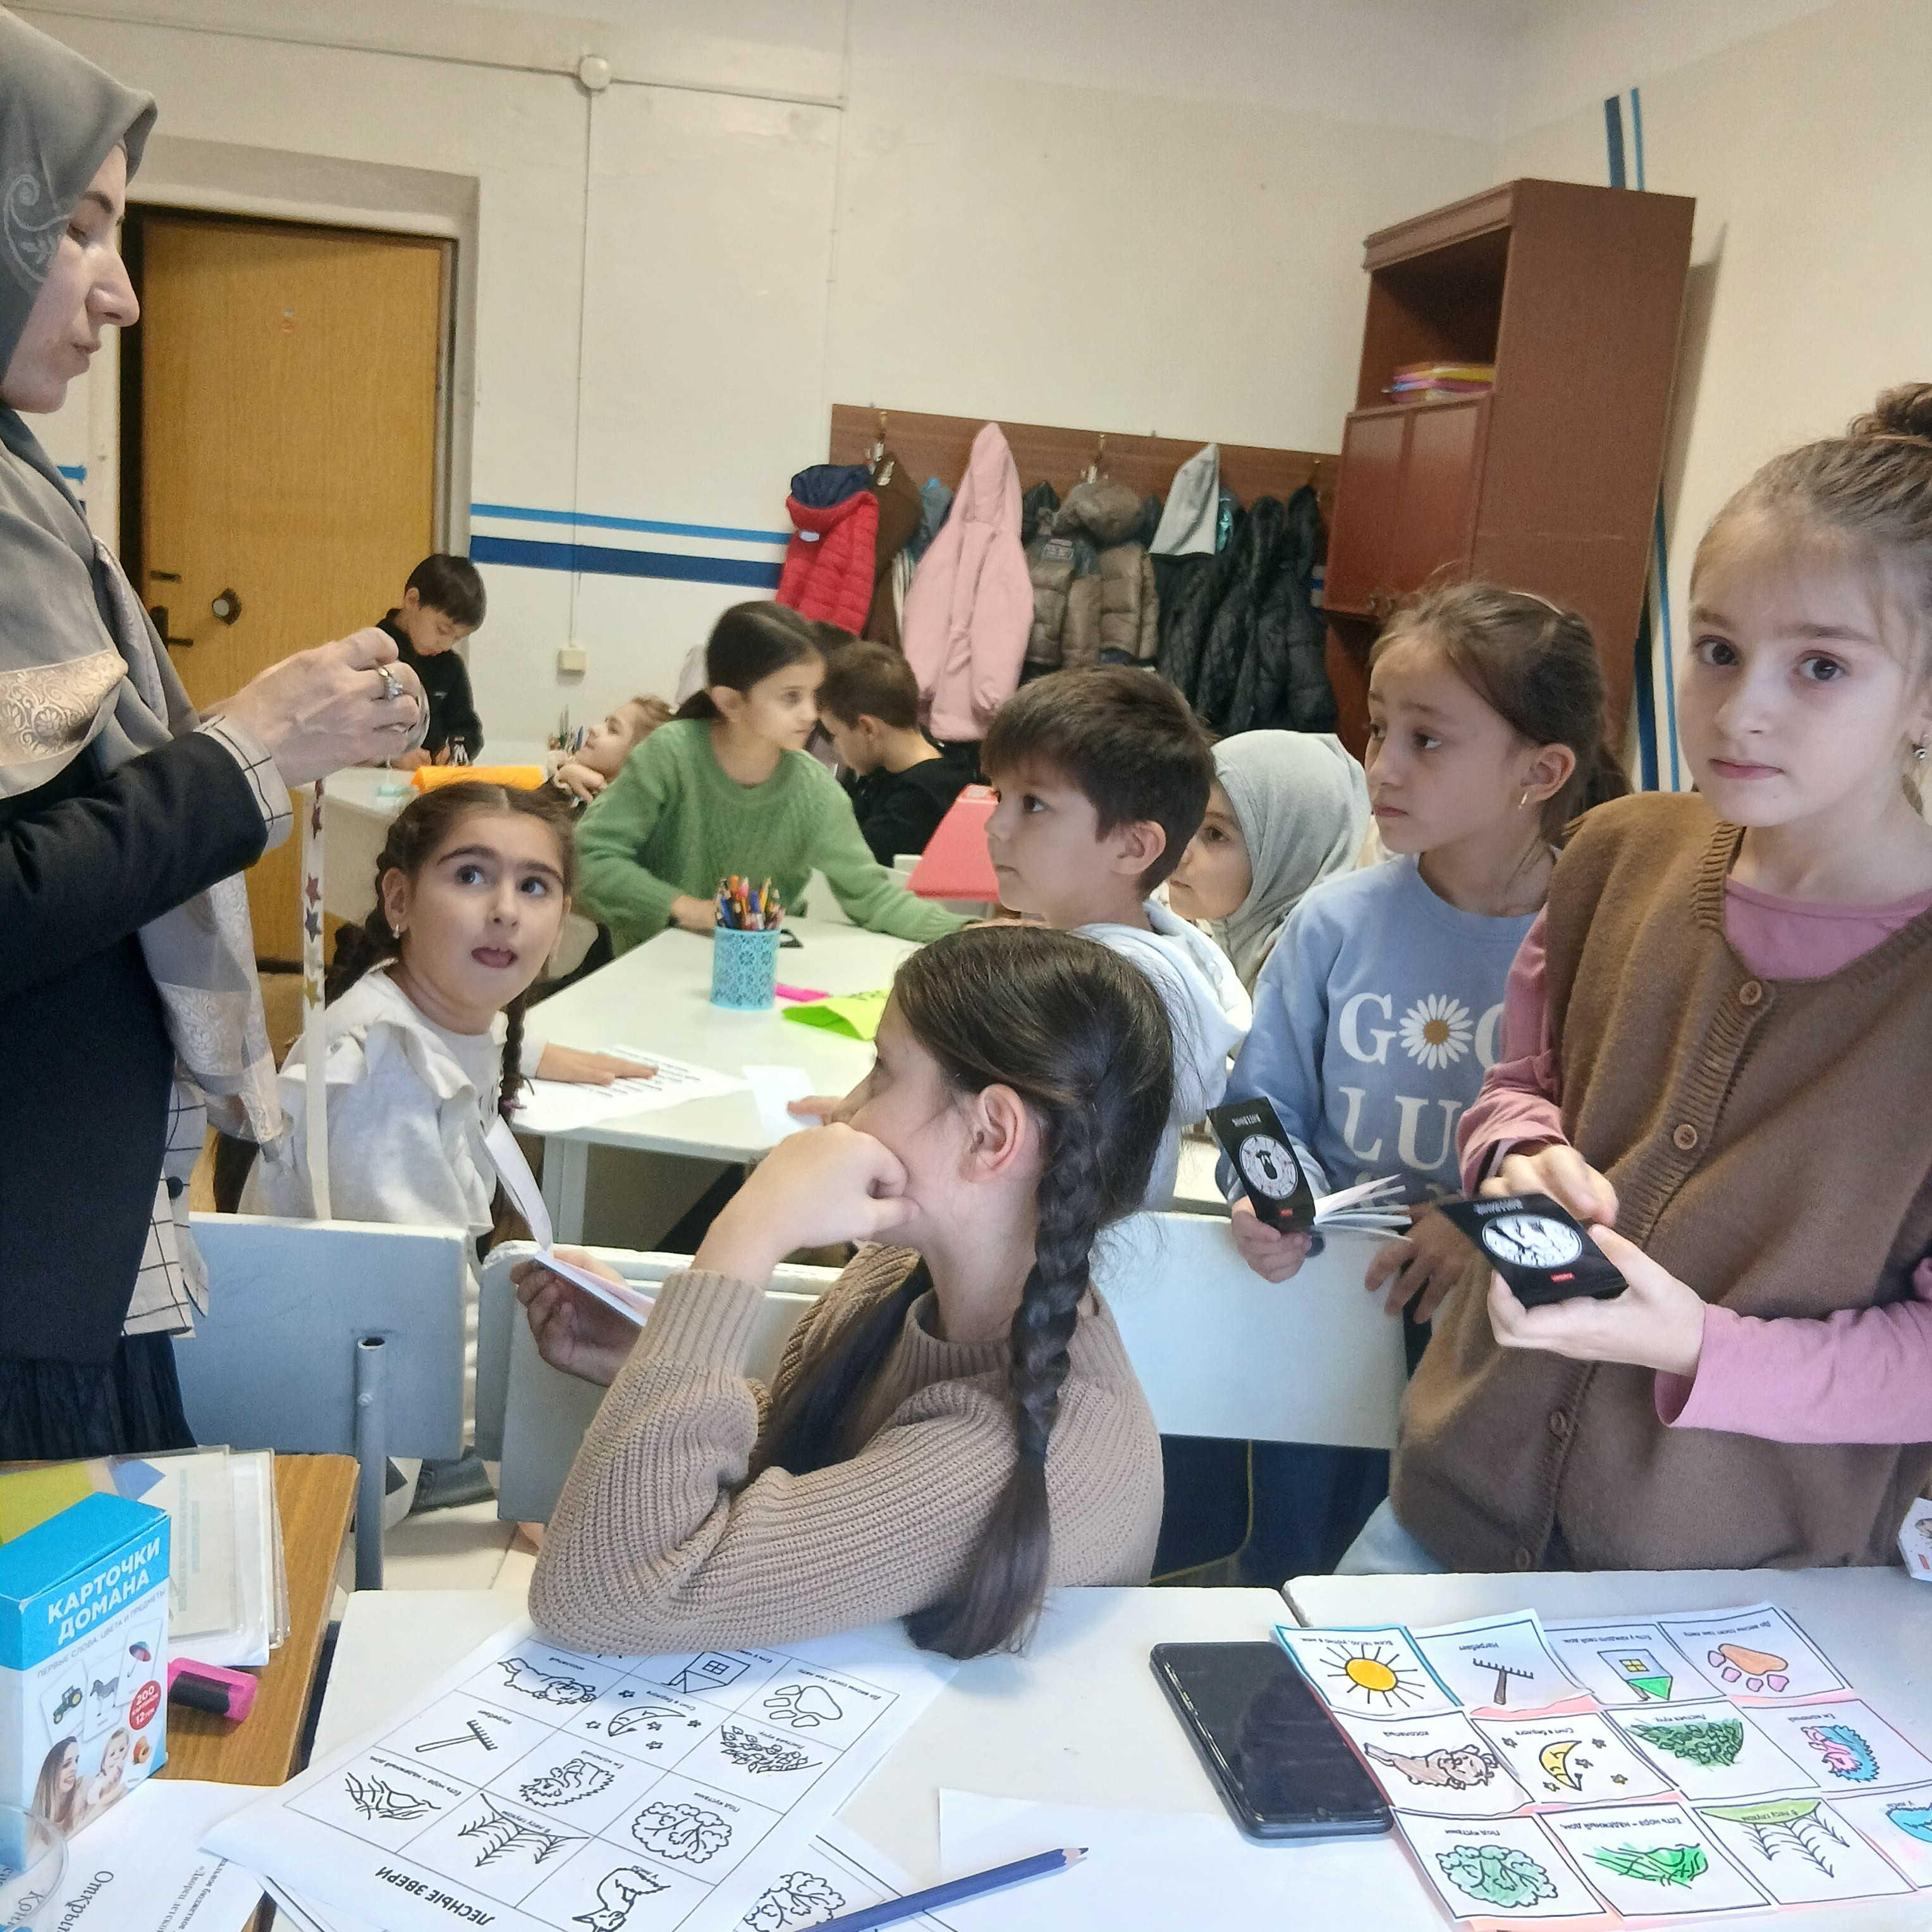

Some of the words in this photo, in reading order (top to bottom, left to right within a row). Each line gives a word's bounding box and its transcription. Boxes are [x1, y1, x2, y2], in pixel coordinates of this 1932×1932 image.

[48, 1536, 161, 1625] КАРТОЧКИ
[58, 1568, 150, 1646] ДОМАНА
[37, 1654, 70, 1678] ПЕРВЫЕ
[71, 1637, 99, 1658] СЛОВА,
[101, 1619, 123, 1639] ЦВЕТА
[124, 1614, 130, 1623] И
[130, 1589, 166, 1619] ПРЕДМЕТЫ
[1458, 1642, 1500, 1651] Нагребает
[136, 1685, 155, 1706] 200
[581, 1749, 613, 1764] колючий
[427, 1779, 446, 1788] нора
[446, 1787, 462, 1796] Есть
[694, 1792, 724, 1806] кустами
[723, 1802, 741, 1813] Под
[501, 1810, 527, 1824] глухом
[1637, 1818, 1661, 1826] нора
[1660, 1817, 1682, 1825] Есть
[528, 1819, 545, 1830] лесу
[1583, 1821, 1630, 1829] надежный
[205, 1857, 228, 1887] пальное
[375, 1866, 429, 1896] ЗВЕРИ
[178, 1888, 211, 1930] бюджетное
[424, 1889, 496, 1926] ЛЕСНЫЕ
